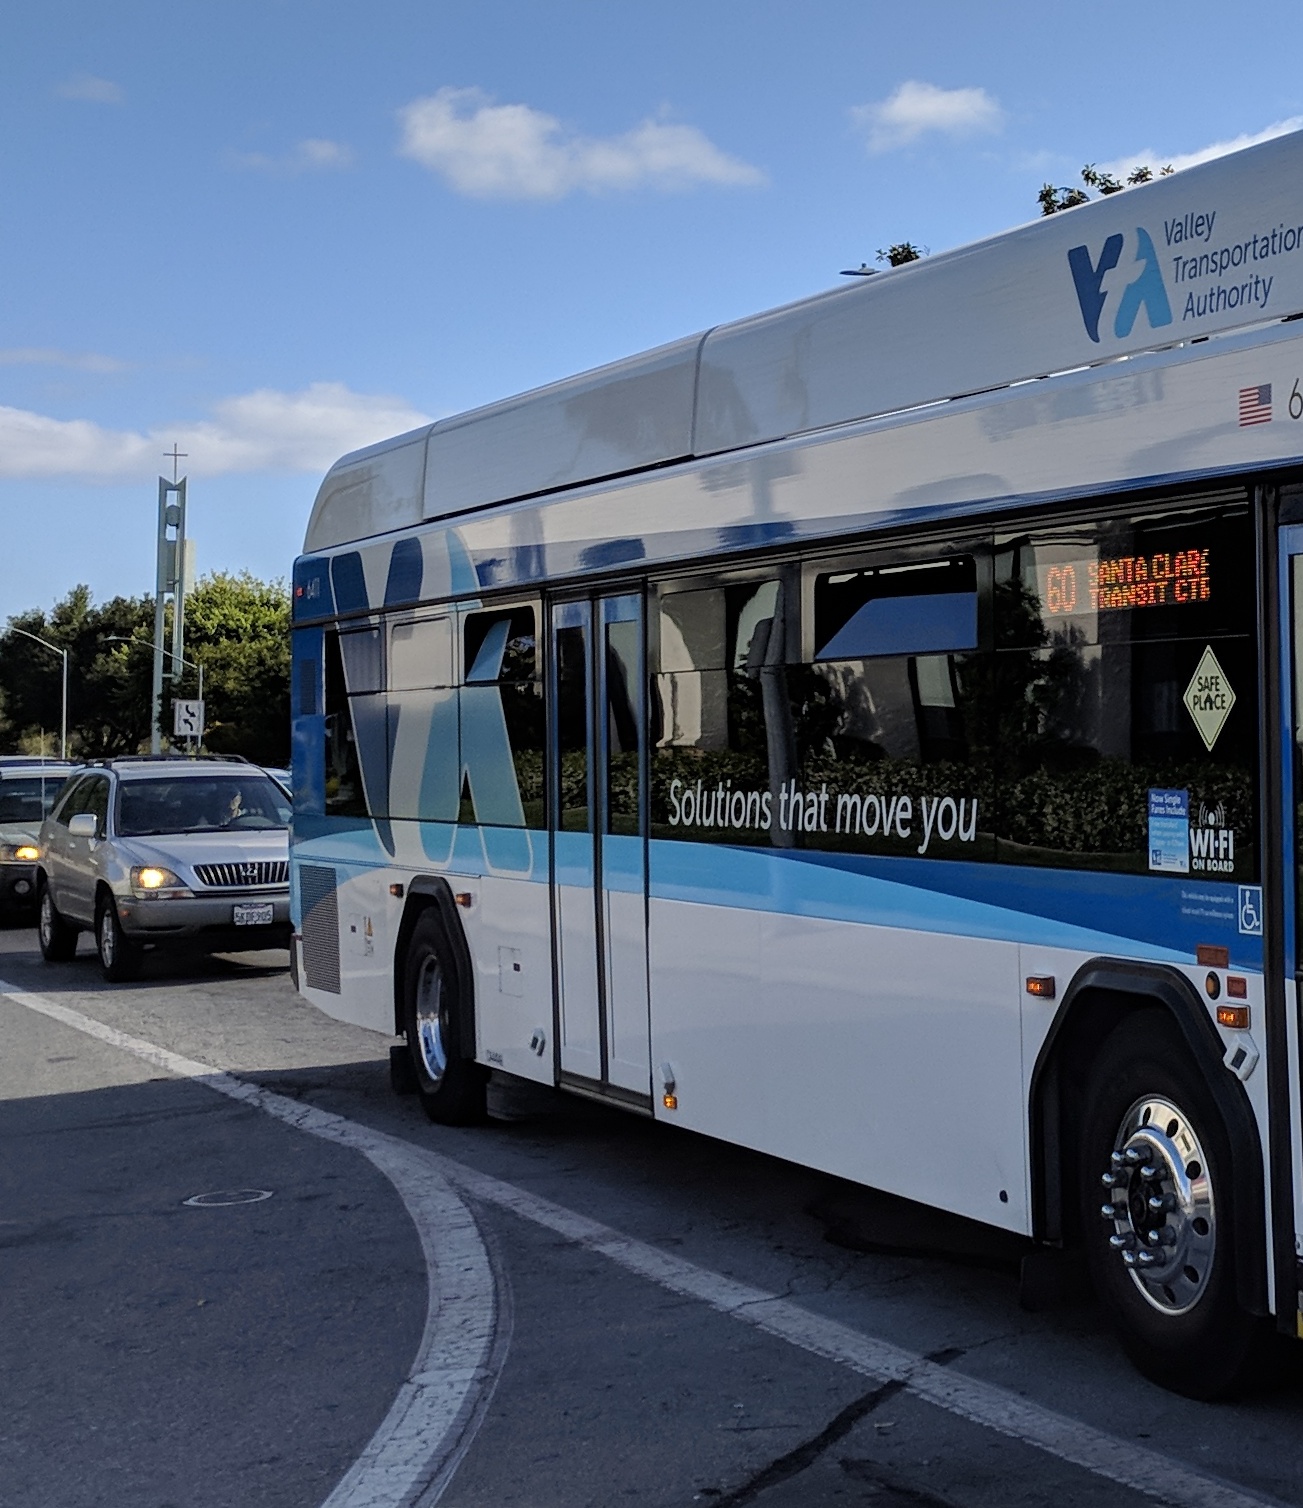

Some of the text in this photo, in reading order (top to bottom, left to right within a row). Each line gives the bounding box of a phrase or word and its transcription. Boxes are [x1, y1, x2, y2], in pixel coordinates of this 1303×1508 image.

[1164, 211, 1216, 246] Valley
[1182, 273, 1274, 321] Authority
[1046, 564, 1076, 613] 60
[1088, 556, 1148, 586] SANTA
[1089, 581, 1169, 609] TRANSIT
[1197, 675, 1220, 692] SAFE
[1192, 692, 1227, 711] PLACE
[667, 778, 978, 854] Solutions that move you
[1191, 858, 1206, 871] ON
[1206, 859, 1235, 873] BOARD
